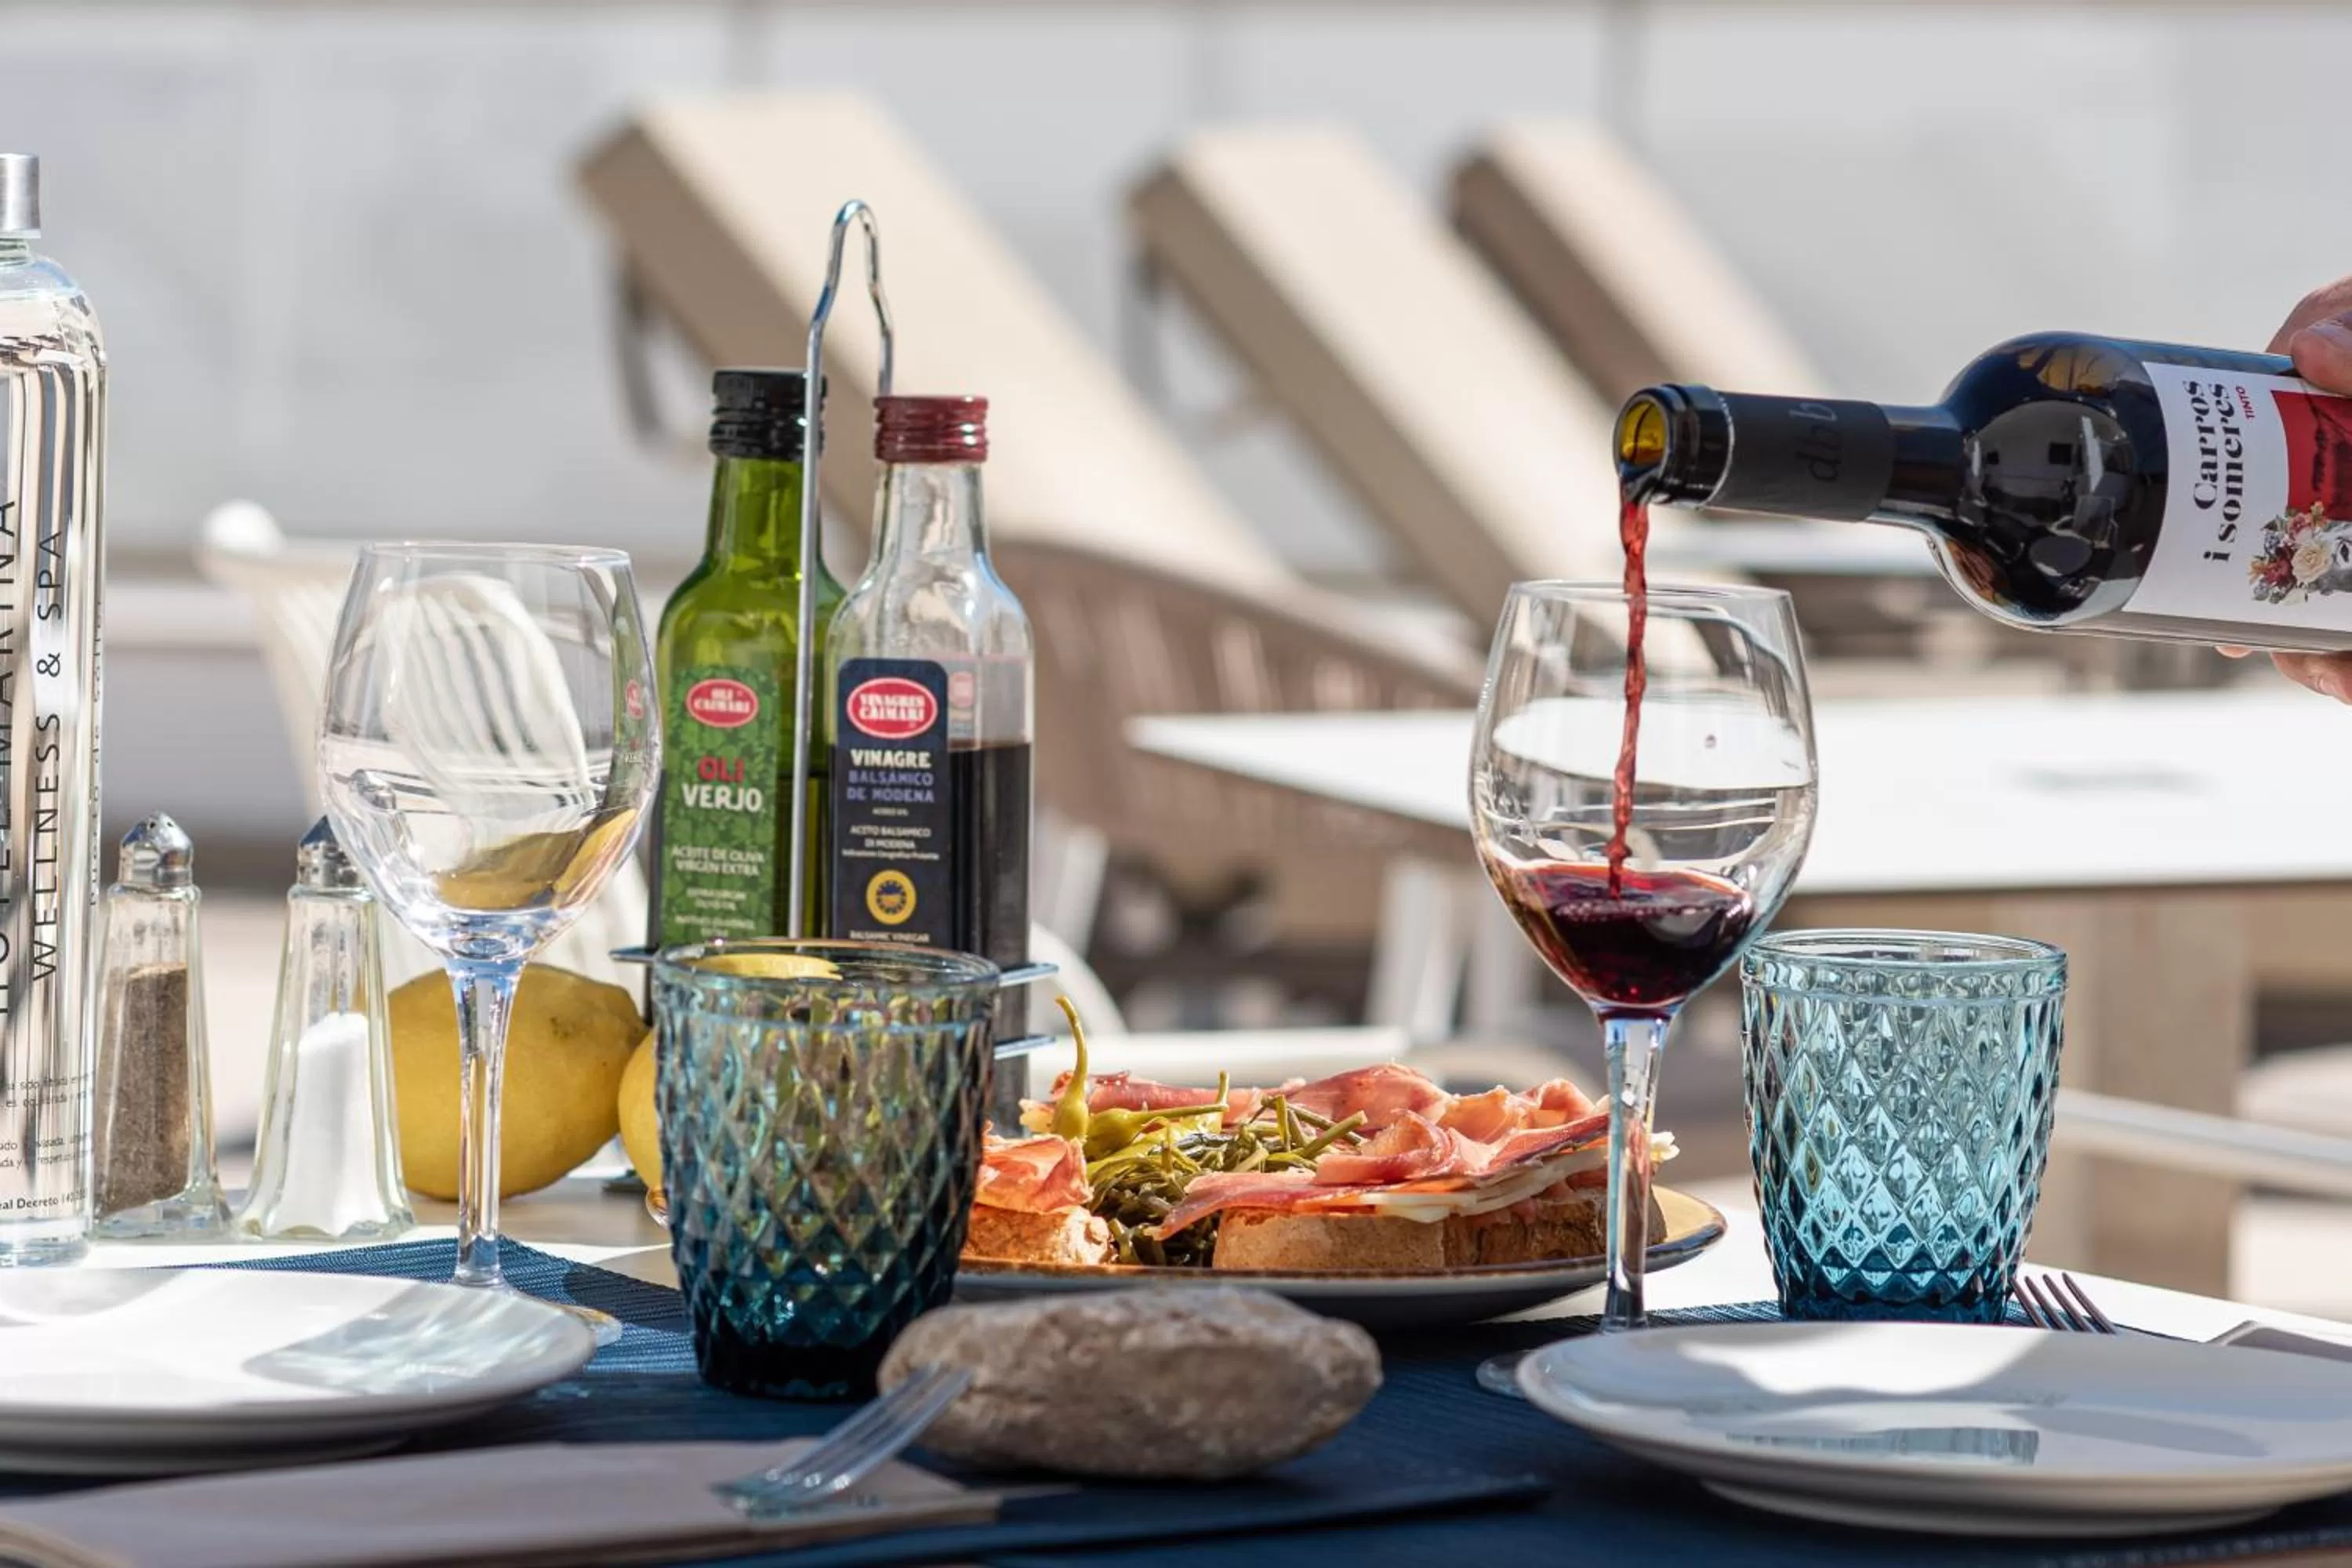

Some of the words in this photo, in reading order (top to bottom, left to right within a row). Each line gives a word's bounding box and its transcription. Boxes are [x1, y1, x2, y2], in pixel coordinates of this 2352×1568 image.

[2235, 385, 2256, 420] TINTO
[2183, 380, 2218, 510] Carros
[2208, 383, 2244, 543] someres
[2203, 550, 2230, 562] i
[37, 531, 62, 621] SPA
[37, 652, 60, 677] &
[698, 754, 744, 783] OLI
[850, 749, 931, 768] VINAGRE
[681, 782, 763, 813] VERJO
[846, 786, 866, 800] DE
[33, 713, 60, 982] WELLNESS
[16, 1196, 59, 1209] Decreto
